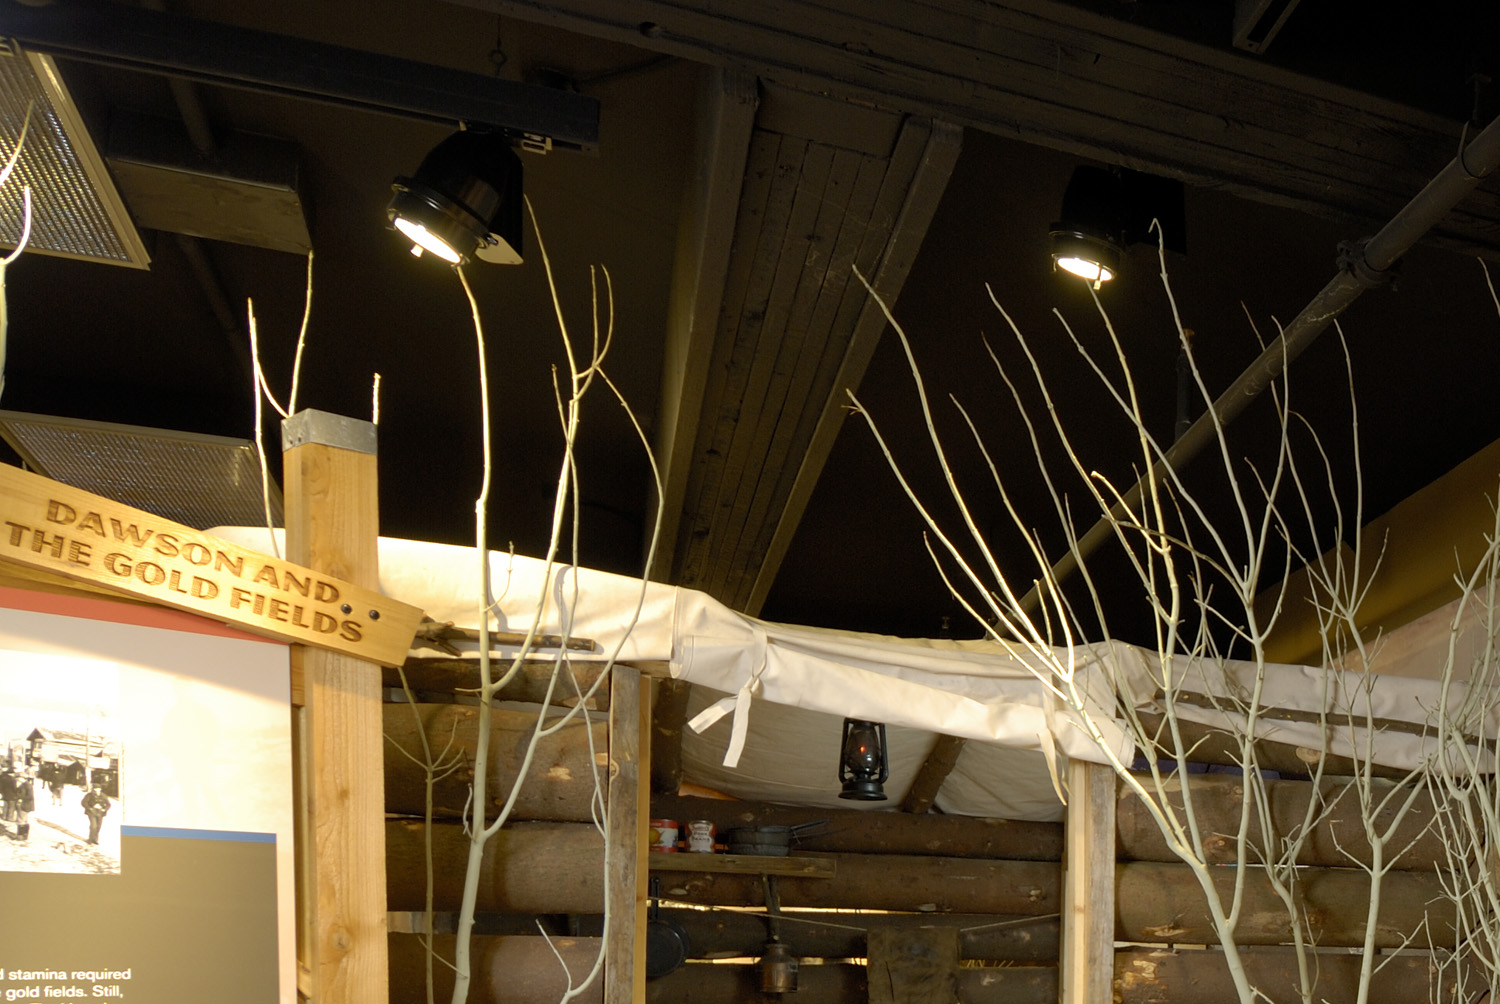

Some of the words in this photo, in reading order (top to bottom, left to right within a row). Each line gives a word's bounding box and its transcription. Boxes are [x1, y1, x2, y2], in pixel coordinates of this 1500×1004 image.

[6, 521, 92, 567] THE
[103, 552, 219, 600] GOLD
[230, 587, 362, 643] FIELDS
[46, 499, 243, 577] DAWSON
[253, 563, 341, 604] AND
[6, 986, 40, 1001] gold
[44, 985, 87, 998] fields.
[92, 984, 123, 998] Still,
[8, 968, 67, 980] stamina
[71, 968, 131, 982] required
